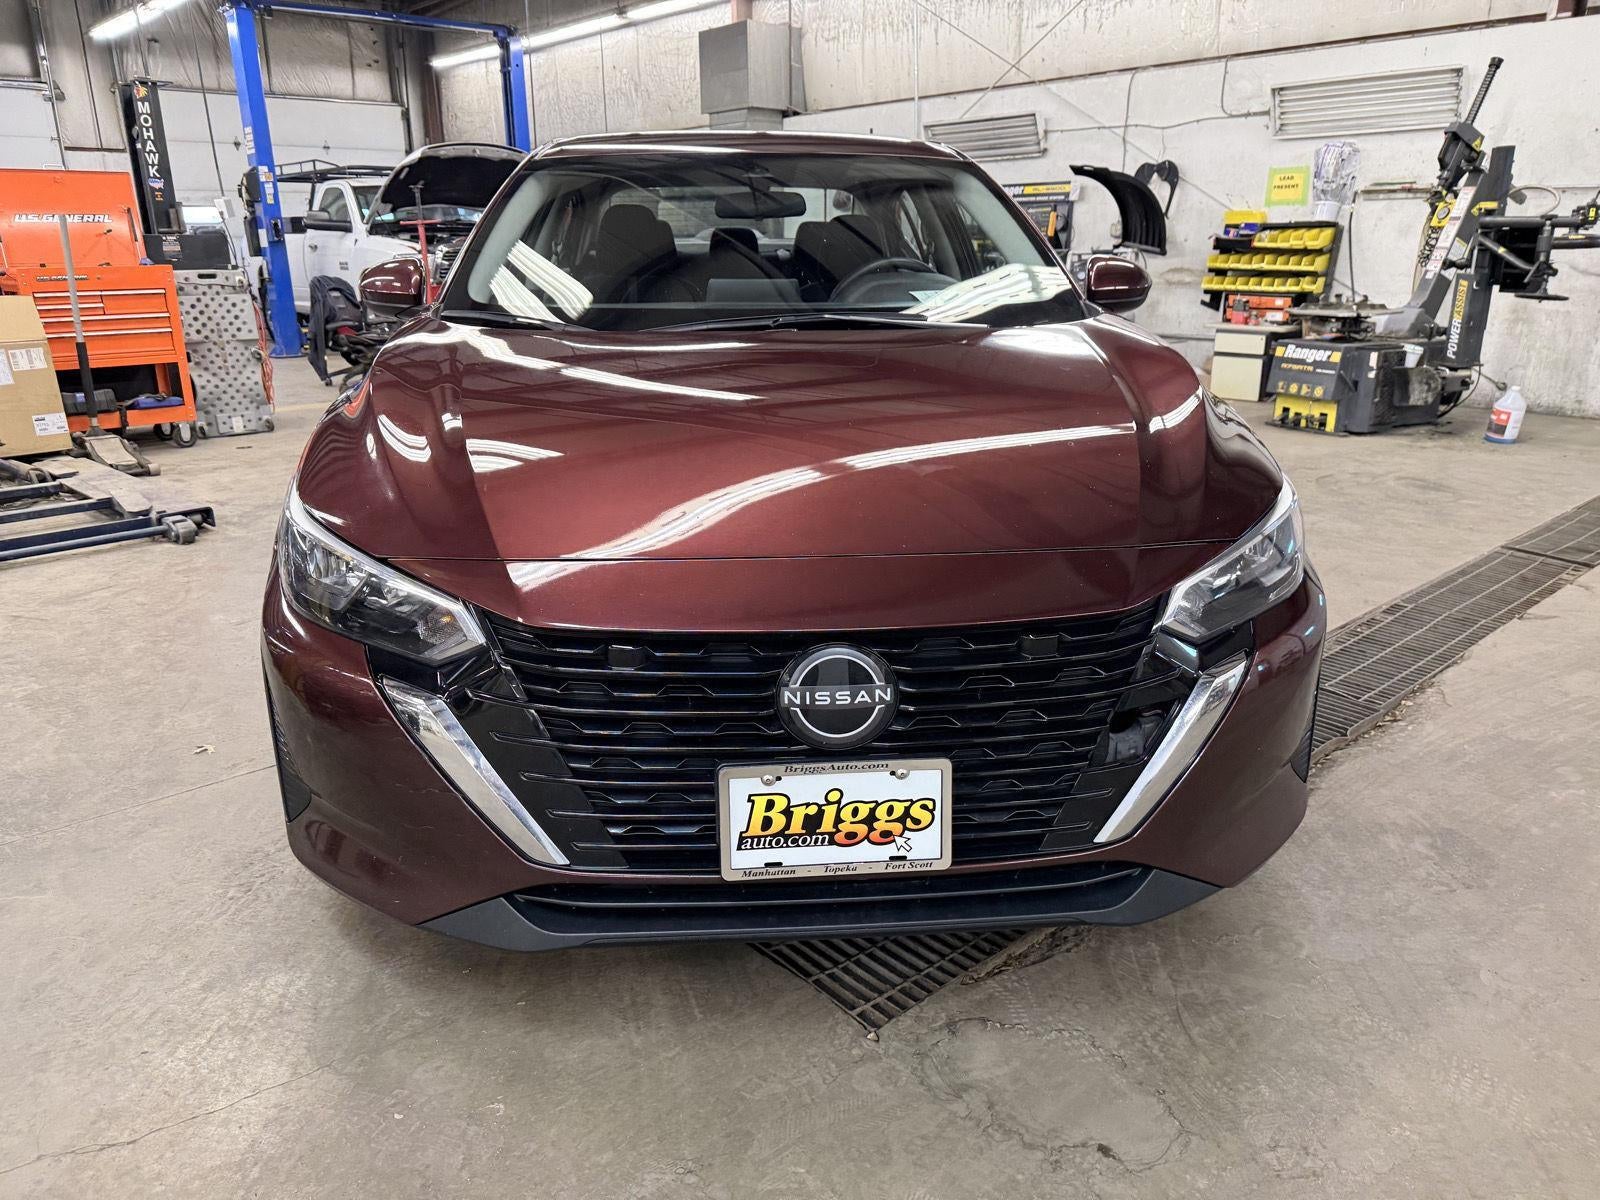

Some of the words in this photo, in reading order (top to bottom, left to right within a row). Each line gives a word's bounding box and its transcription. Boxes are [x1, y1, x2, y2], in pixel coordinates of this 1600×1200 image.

[137, 101, 161, 178] MOHAWK
[1446, 319, 1462, 359] POWER
[1284, 344, 1332, 363] Ranger
[784, 687, 891, 705] NISSAN
[784, 763, 889, 774] BriggsAuto.com
[741, 788, 936, 847] Briggs
[741, 834, 829, 850] auto.com
[741, 869, 796, 878] Manhattan
[824, 865, 857, 875] Topeka
[907, 861, 933, 869] Scott
